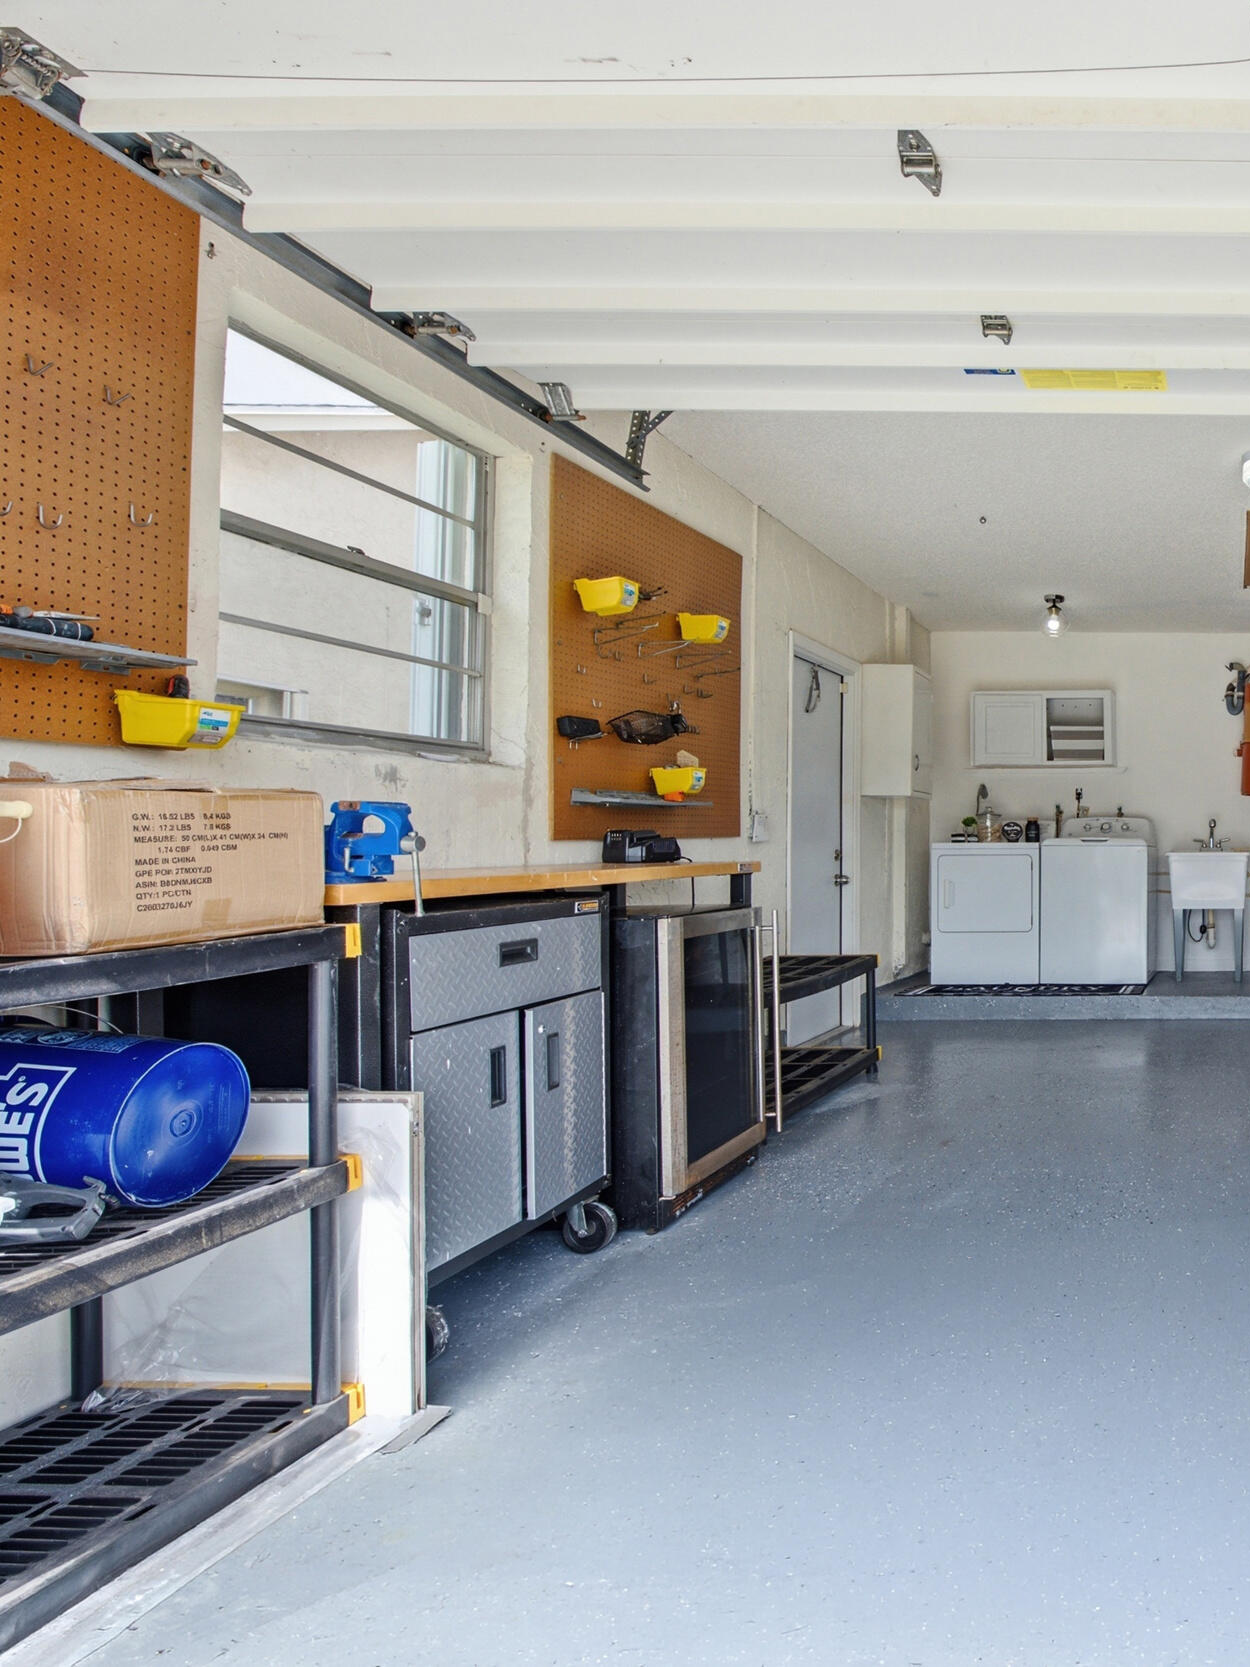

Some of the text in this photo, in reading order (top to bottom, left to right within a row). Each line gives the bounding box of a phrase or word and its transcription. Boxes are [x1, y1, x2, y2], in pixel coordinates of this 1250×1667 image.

[131, 812, 155, 821] G.W.:
[179, 812, 196, 821] LBS
[132, 824, 155, 832] N.W.:
[175, 823, 192, 832] LBS
[215, 823, 232, 831] KGS
[133, 835, 178, 843] MEASURE:
[174, 845, 191, 853] CBF
[220, 843, 238, 852] CBM
[134, 856, 197, 866] MADE IN CHINA
[134, 869, 153, 878] GPE
